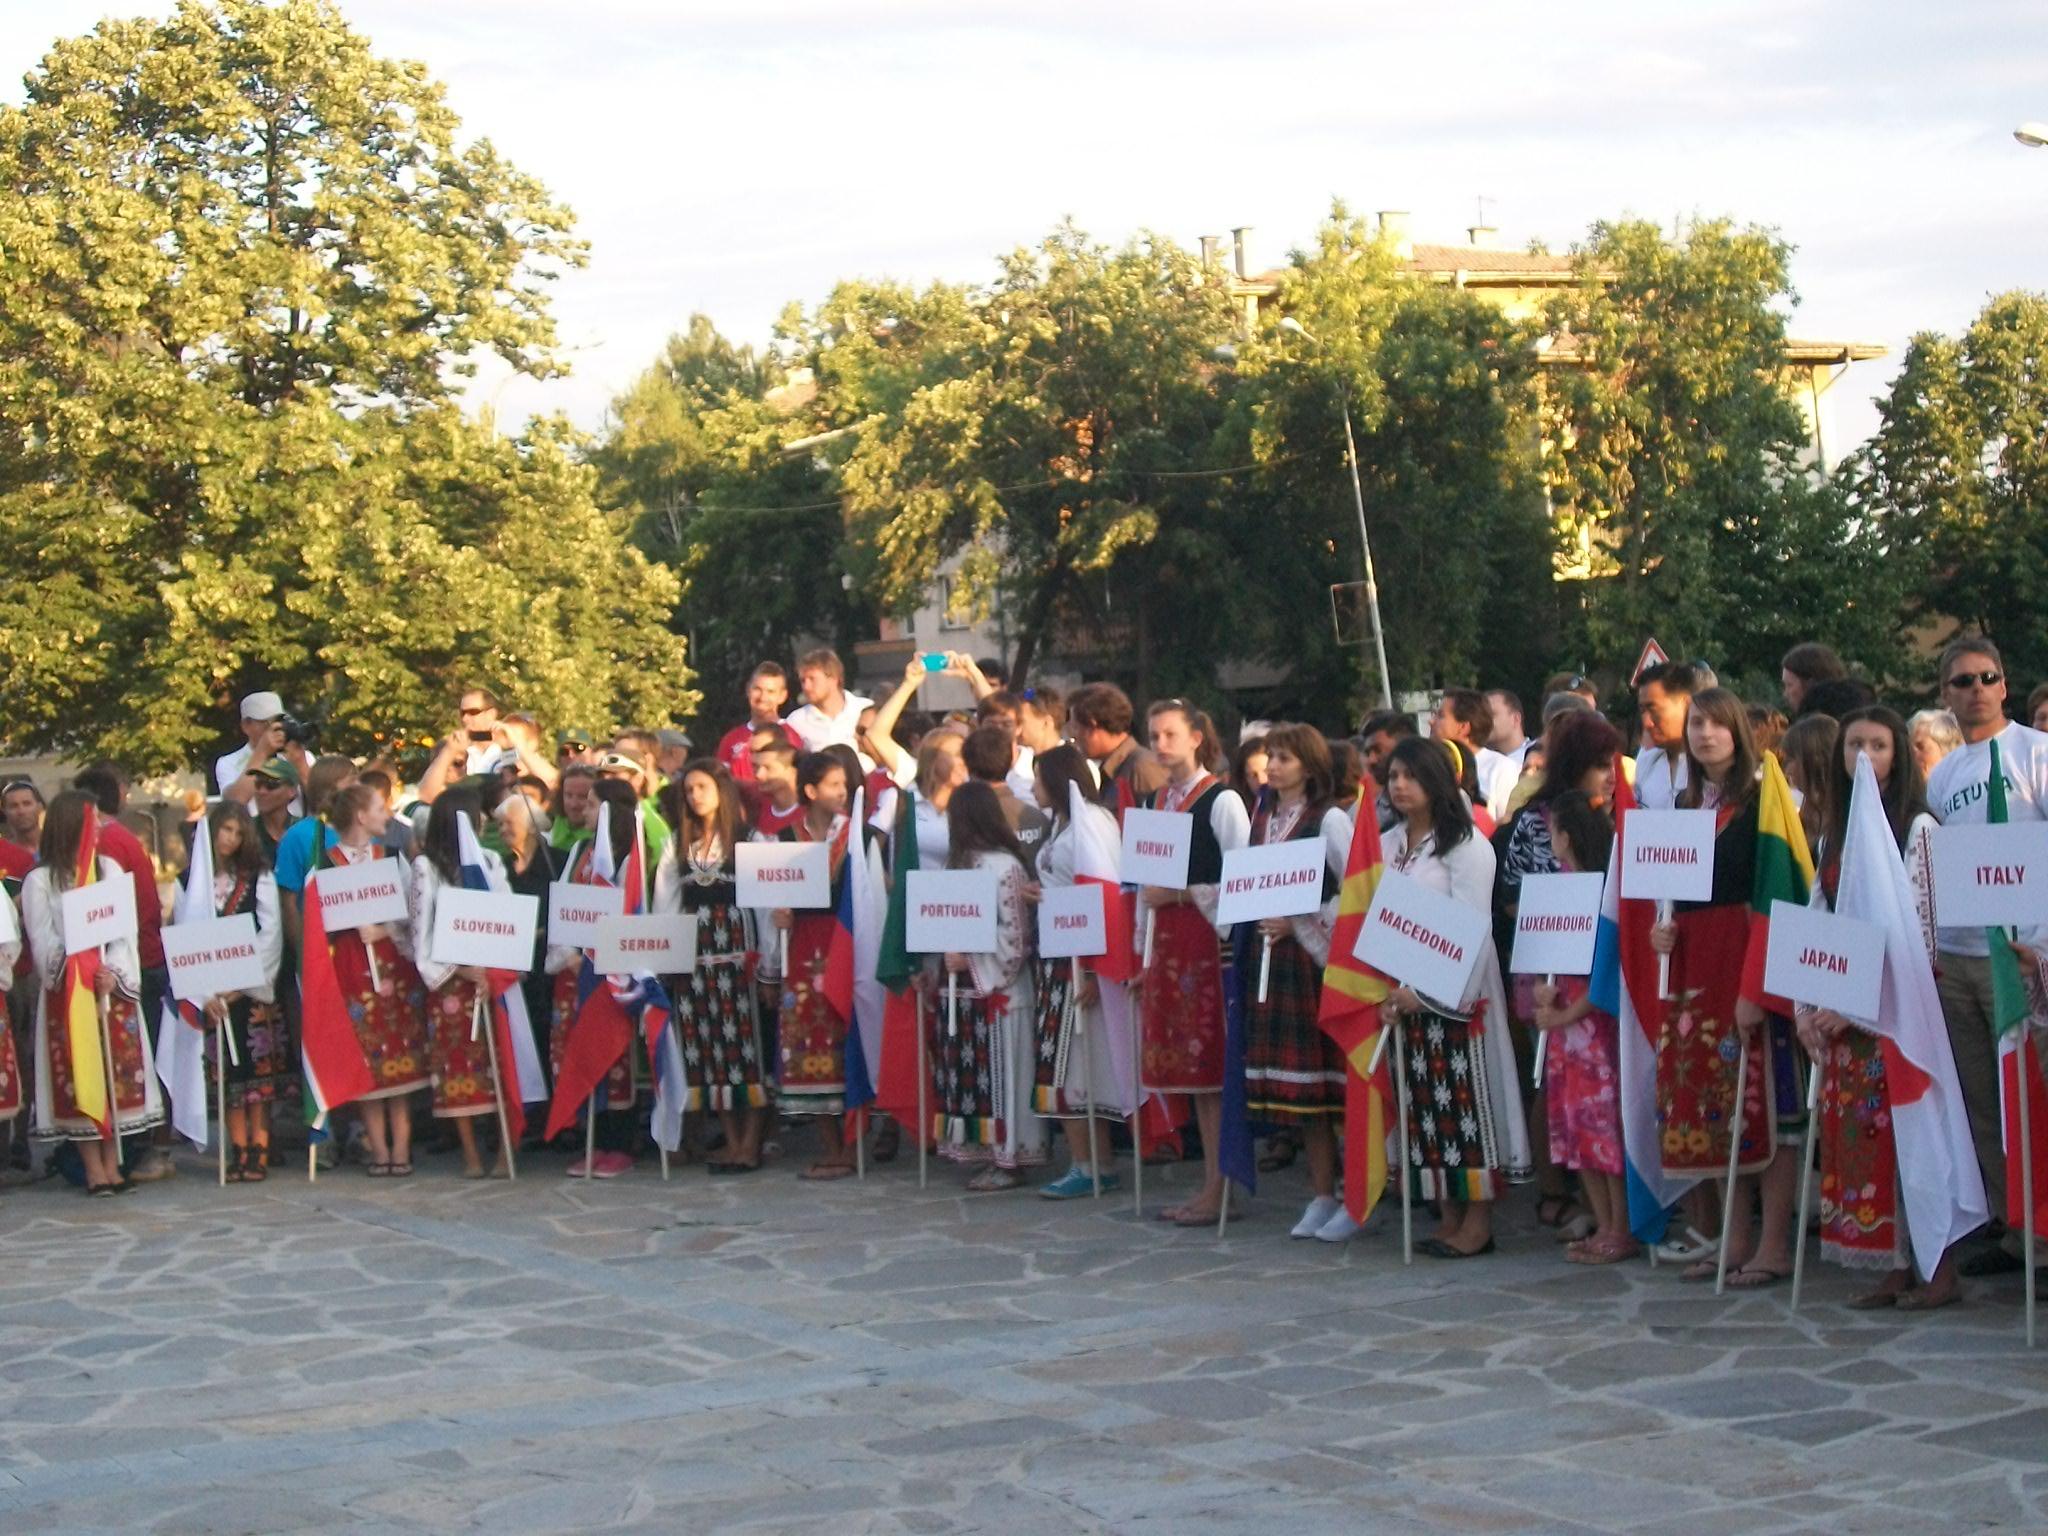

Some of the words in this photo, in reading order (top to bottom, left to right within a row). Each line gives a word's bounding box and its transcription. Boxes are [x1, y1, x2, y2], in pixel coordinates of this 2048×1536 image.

[1136, 840, 1174, 858] NORWAY
[1636, 846, 1698, 865] LITHUANIA
[757, 867, 806, 883] RUSSIA
[1226, 875, 1255, 894] NEW
[1258, 867, 1317, 890] ZEALAND
[1976, 865, 2025, 886] ITALY
[357, 883, 397, 901] AFRICA
[86, 904, 115, 923] SPAIN
[560, 908, 608, 923] SLOVAK
[920, 903, 981, 918] PORTUGAL
[453, 918, 516, 936] SLOVENIA
[1053, 914, 1088, 930] POLAND
[1519, 913, 1593, 933] LUXEMBOURG
[1378, 906, 1464, 964] MACEDONIA
[619, 938, 671, 952] SERBIA
[172, 951, 212, 968] SOUTH
[215, 943, 256, 961] KOREA
[1799, 947, 1849, 974] JAPAN
